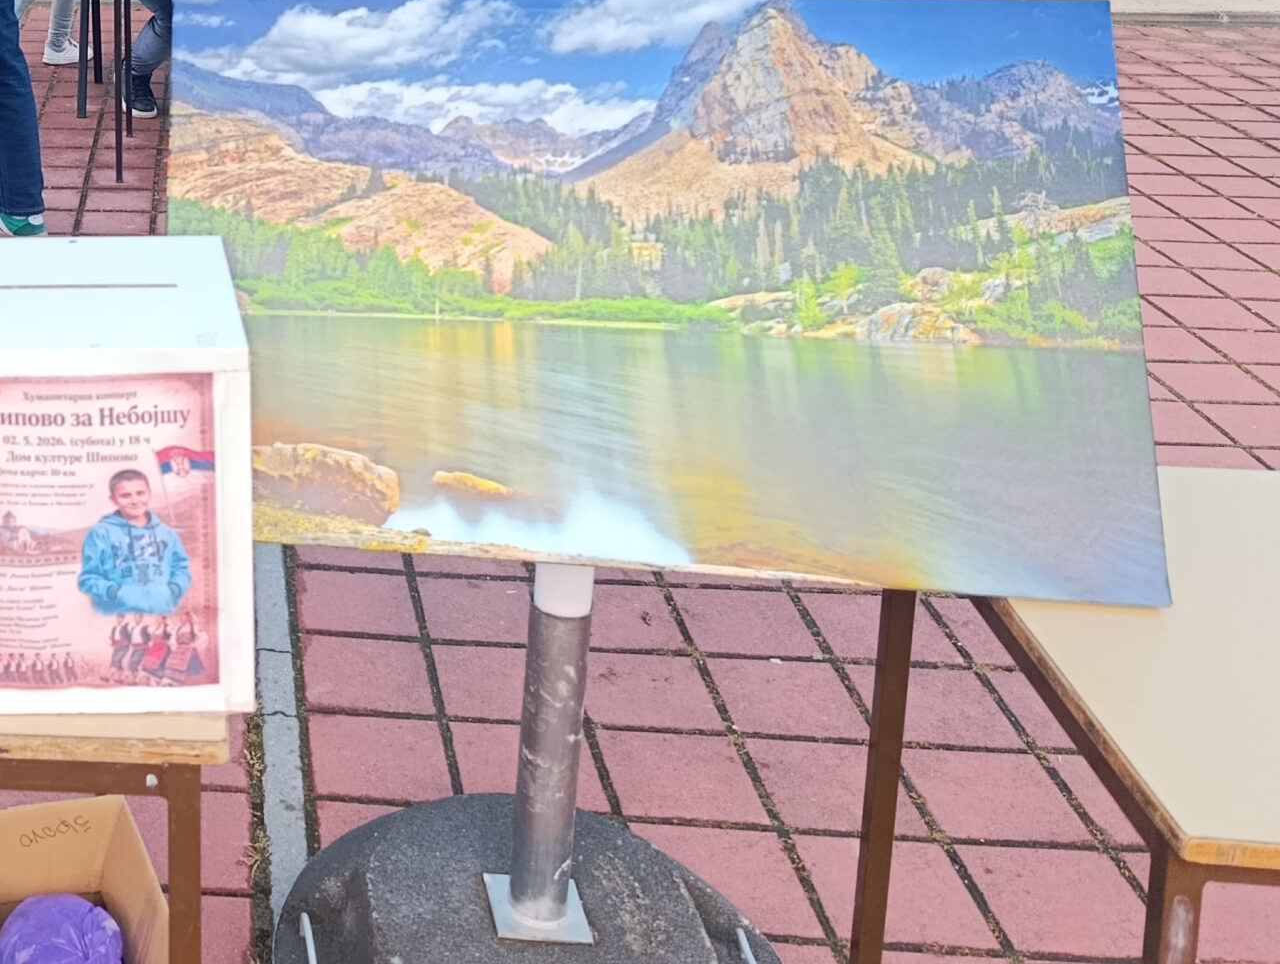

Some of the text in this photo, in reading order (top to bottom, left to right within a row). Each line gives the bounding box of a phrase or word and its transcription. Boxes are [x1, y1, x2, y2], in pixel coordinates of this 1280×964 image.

[70, 412, 93, 427] за
[98, 404, 191, 428] Небојшу
[5, 450, 138, 465] Дом културе Шипово
